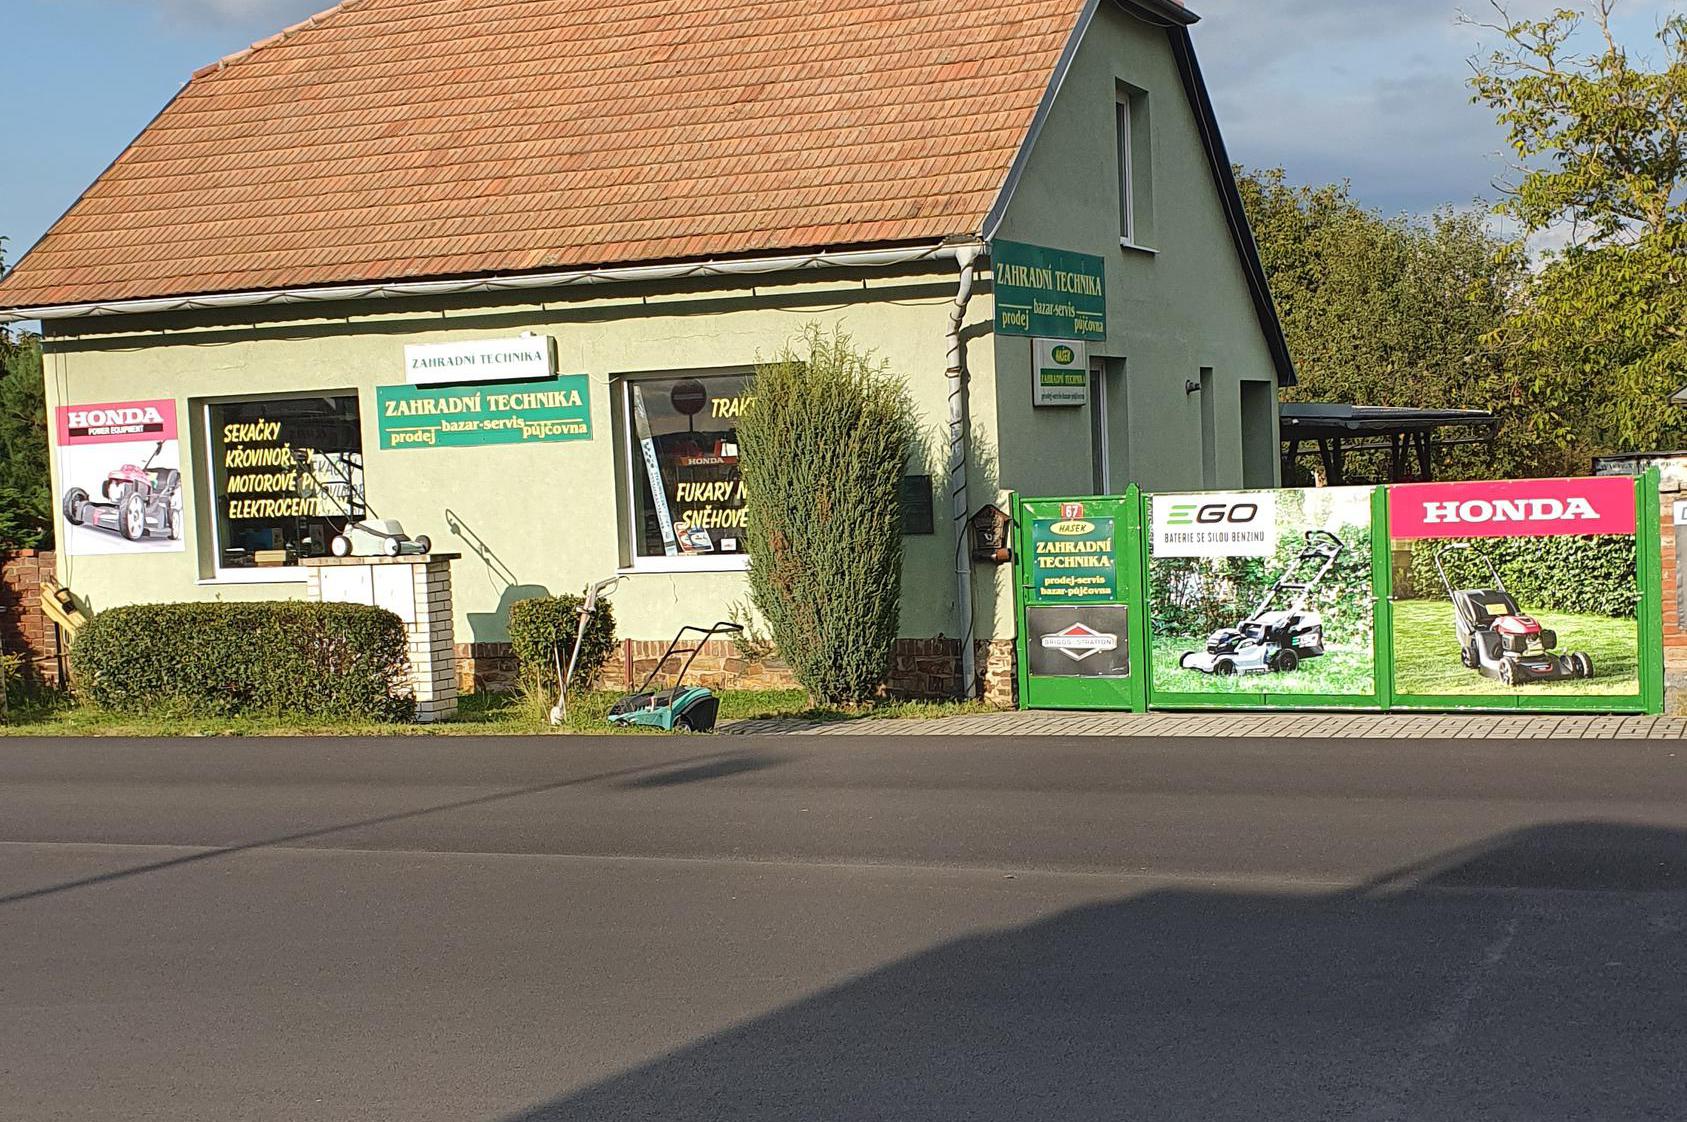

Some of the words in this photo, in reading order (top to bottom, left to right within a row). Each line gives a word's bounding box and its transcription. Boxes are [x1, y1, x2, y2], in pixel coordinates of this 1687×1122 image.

[997, 263, 1053, 290] ZAHRADNÍ
[1055, 271, 1102, 296] TECHNIKA
[1002, 310, 1029, 331] prodej
[1033, 298, 1076, 318] bazar-servis
[480, 351, 543, 364] TECHNIKA
[384, 392, 481, 416] ZAHRADNÍ
[487, 390, 583, 411] TECHNIKA
[711, 397, 758, 418] TRAKT
[68, 407, 164, 429] HONDA
[224, 418, 281, 443] SEKAČKY
[391, 428, 436, 445] prodej
[441, 415, 525, 431] bazar-servis
[523, 422, 587, 439] půjčovna
[225, 442, 315, 468] KŘOVINOŘY
[688, 457, 725, 465] HONDA
[227, 469, 297, 493] MOTOROVÉ
[676, 481, 734, 502] FUKARY
[737, 480, 749, 499] N
[682, 504, 749, 530] SNĚHOVÉ
[1065, 505, 1079, 518] 67
[1166, 503, 1258, 525] EGO
[1423, 498, 1600, 523] HONDA
[1036, 537, 1112, 554] ZAHRADNÍ
[1164, 532, 1194, 543] BATERIE
[1196, 532, 1205, 543] SE
[1208, 531, 1229, 543] SILOU
[1037, 556, 1112, 568] TECHNIKA
[1044, 575, 1105, 586] prodej-servis
